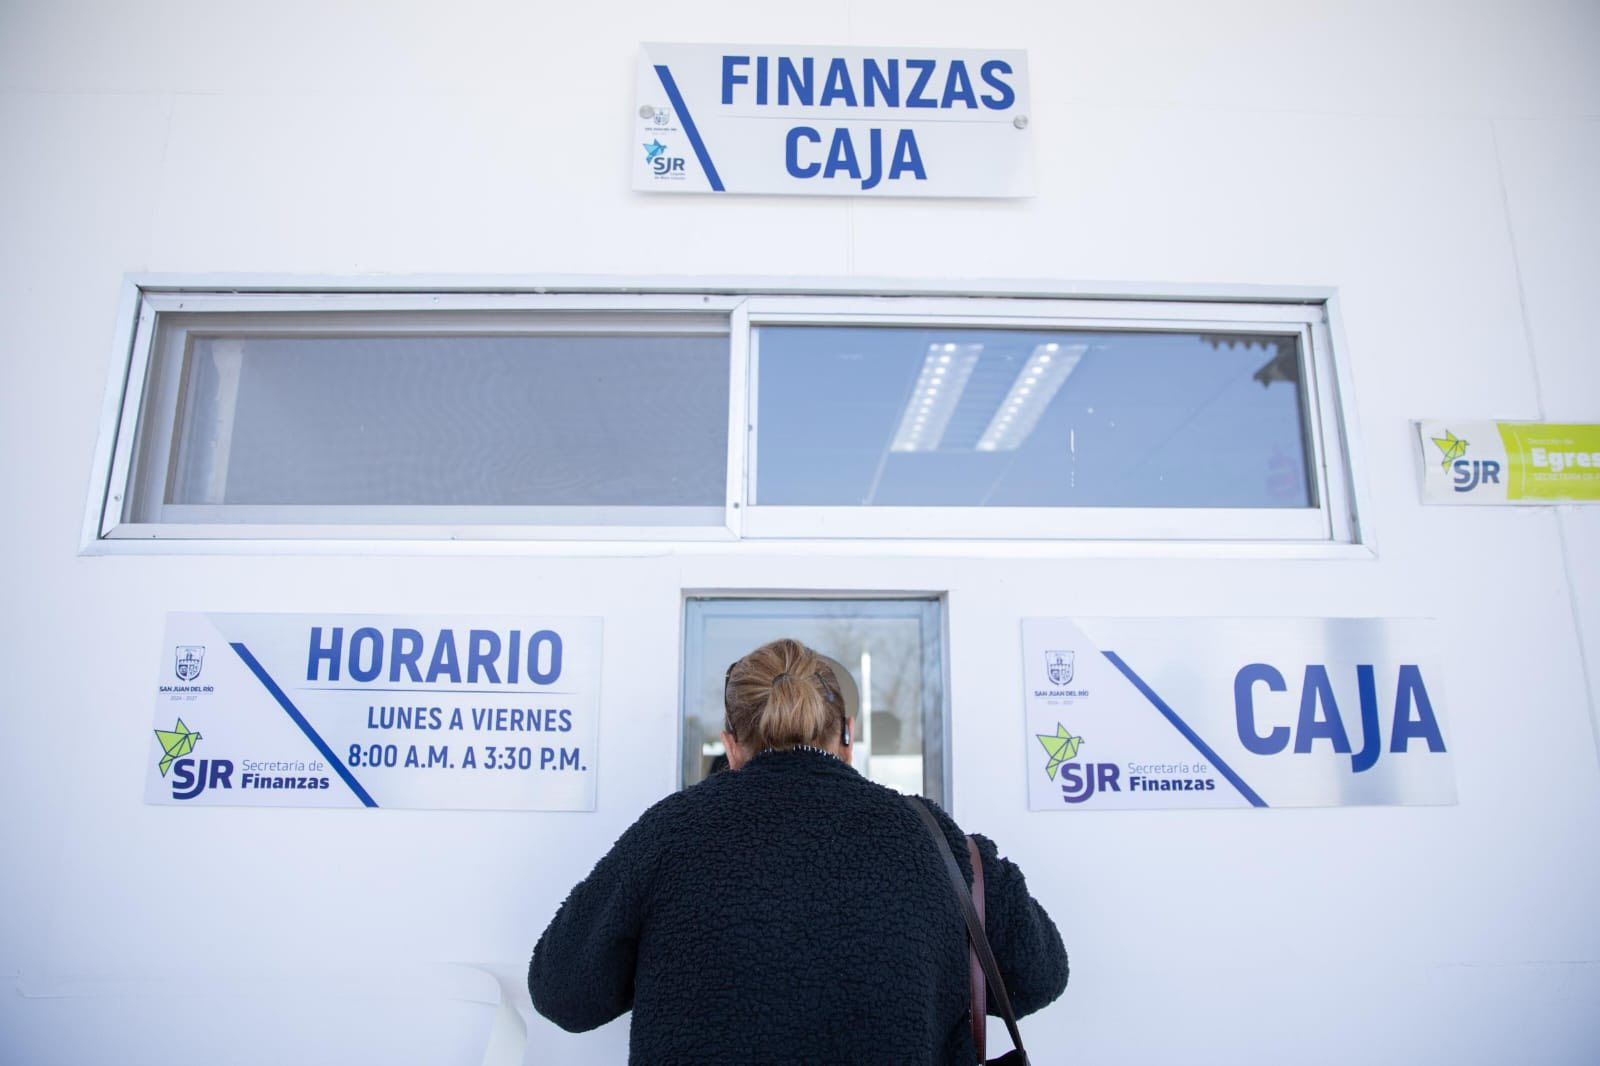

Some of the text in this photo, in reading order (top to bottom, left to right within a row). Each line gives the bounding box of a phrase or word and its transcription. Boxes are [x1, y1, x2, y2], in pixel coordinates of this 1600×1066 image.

[722, 56, 1015, 110] FINANZAS
[653, 157, 685, 175] SJR
[785, 127, 927, 190] CAJA
[1453, 460, 1500, 492] SJR
[307, 627, 563, 685] HORARIO
[367, 706, 572, 732] LUNES A VIERNES
[1234, 663, 1447, 773] CAJA
[308, 760, 324, 771] de
[348, 743, 587, 771] 8:00 A.M. A 3:30 P.M.
[1192, 762, 1207, 774] de
[172, 758, 234, 800] SJR
[241, 773, 329, 789] Finanzas
[1060, 763, 1121, 804] SJR
[1129, 776, 1215, 792] Finanzas
